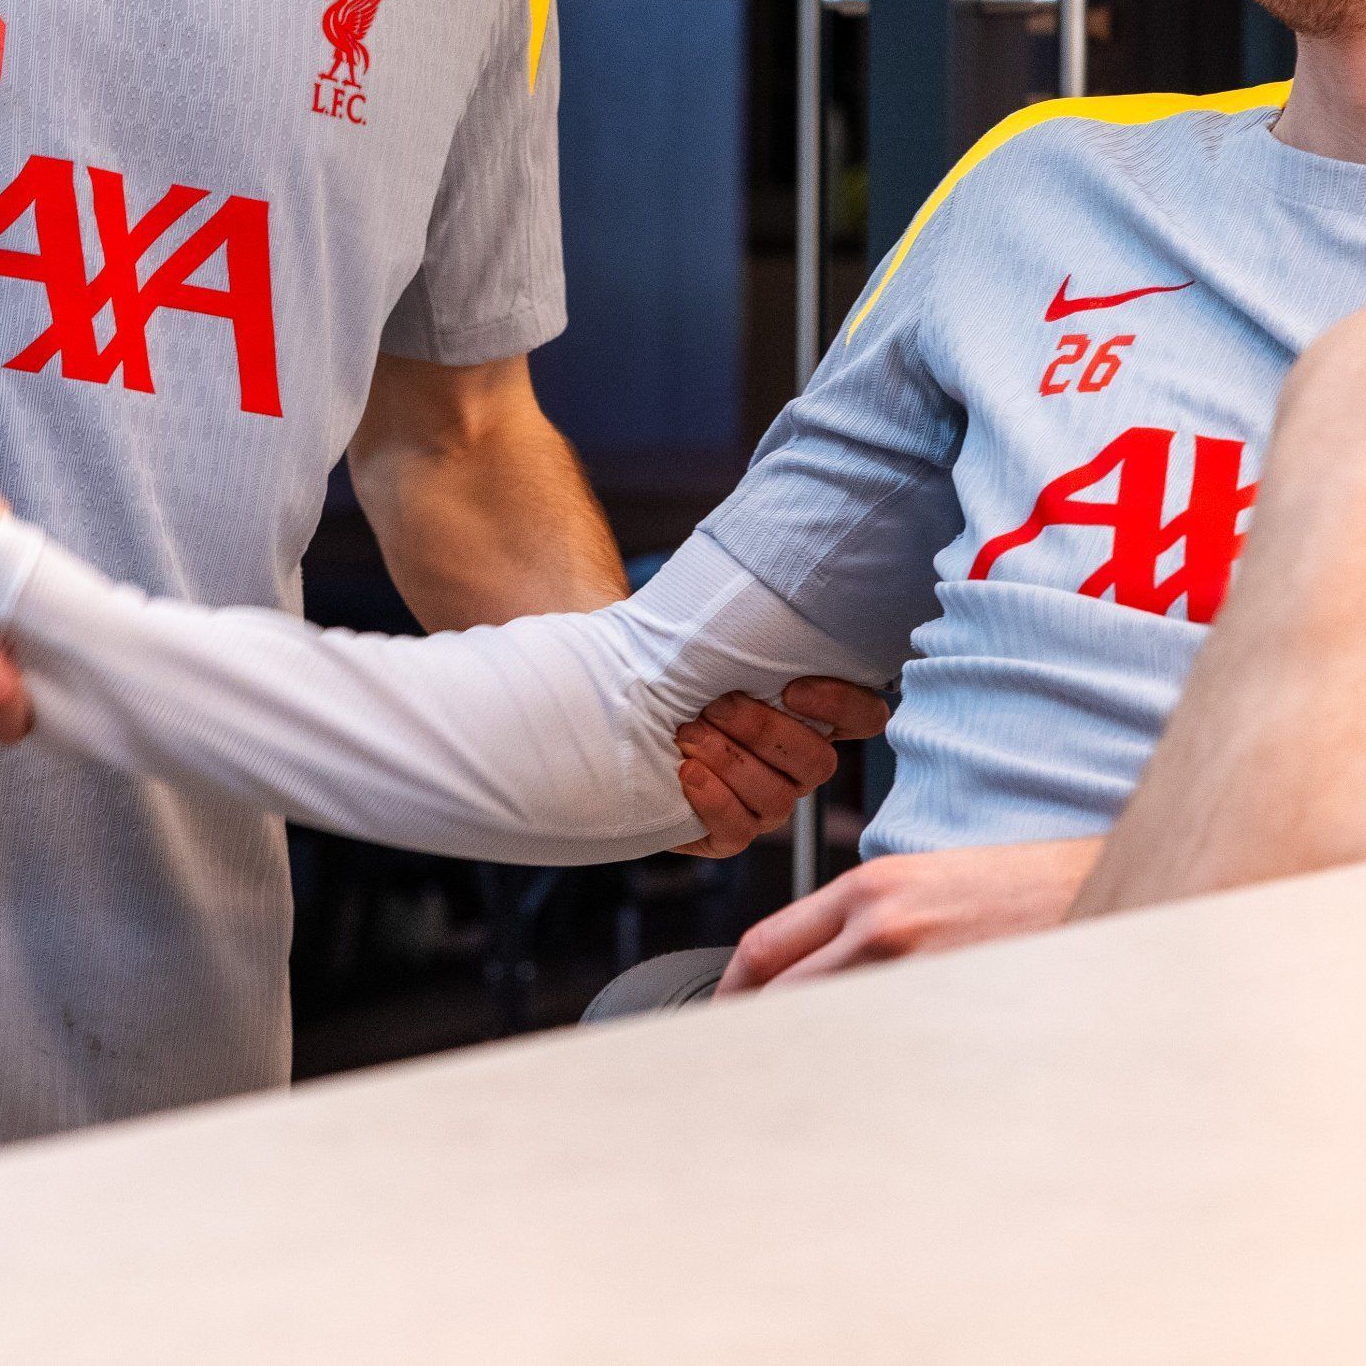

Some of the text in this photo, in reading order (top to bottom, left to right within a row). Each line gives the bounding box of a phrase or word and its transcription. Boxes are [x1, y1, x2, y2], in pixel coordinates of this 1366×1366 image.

[311, 82, 367, 126] L.F.C.
[1038, 334, 1136, 397] 26
[967, 426, 1260, 626] AX
